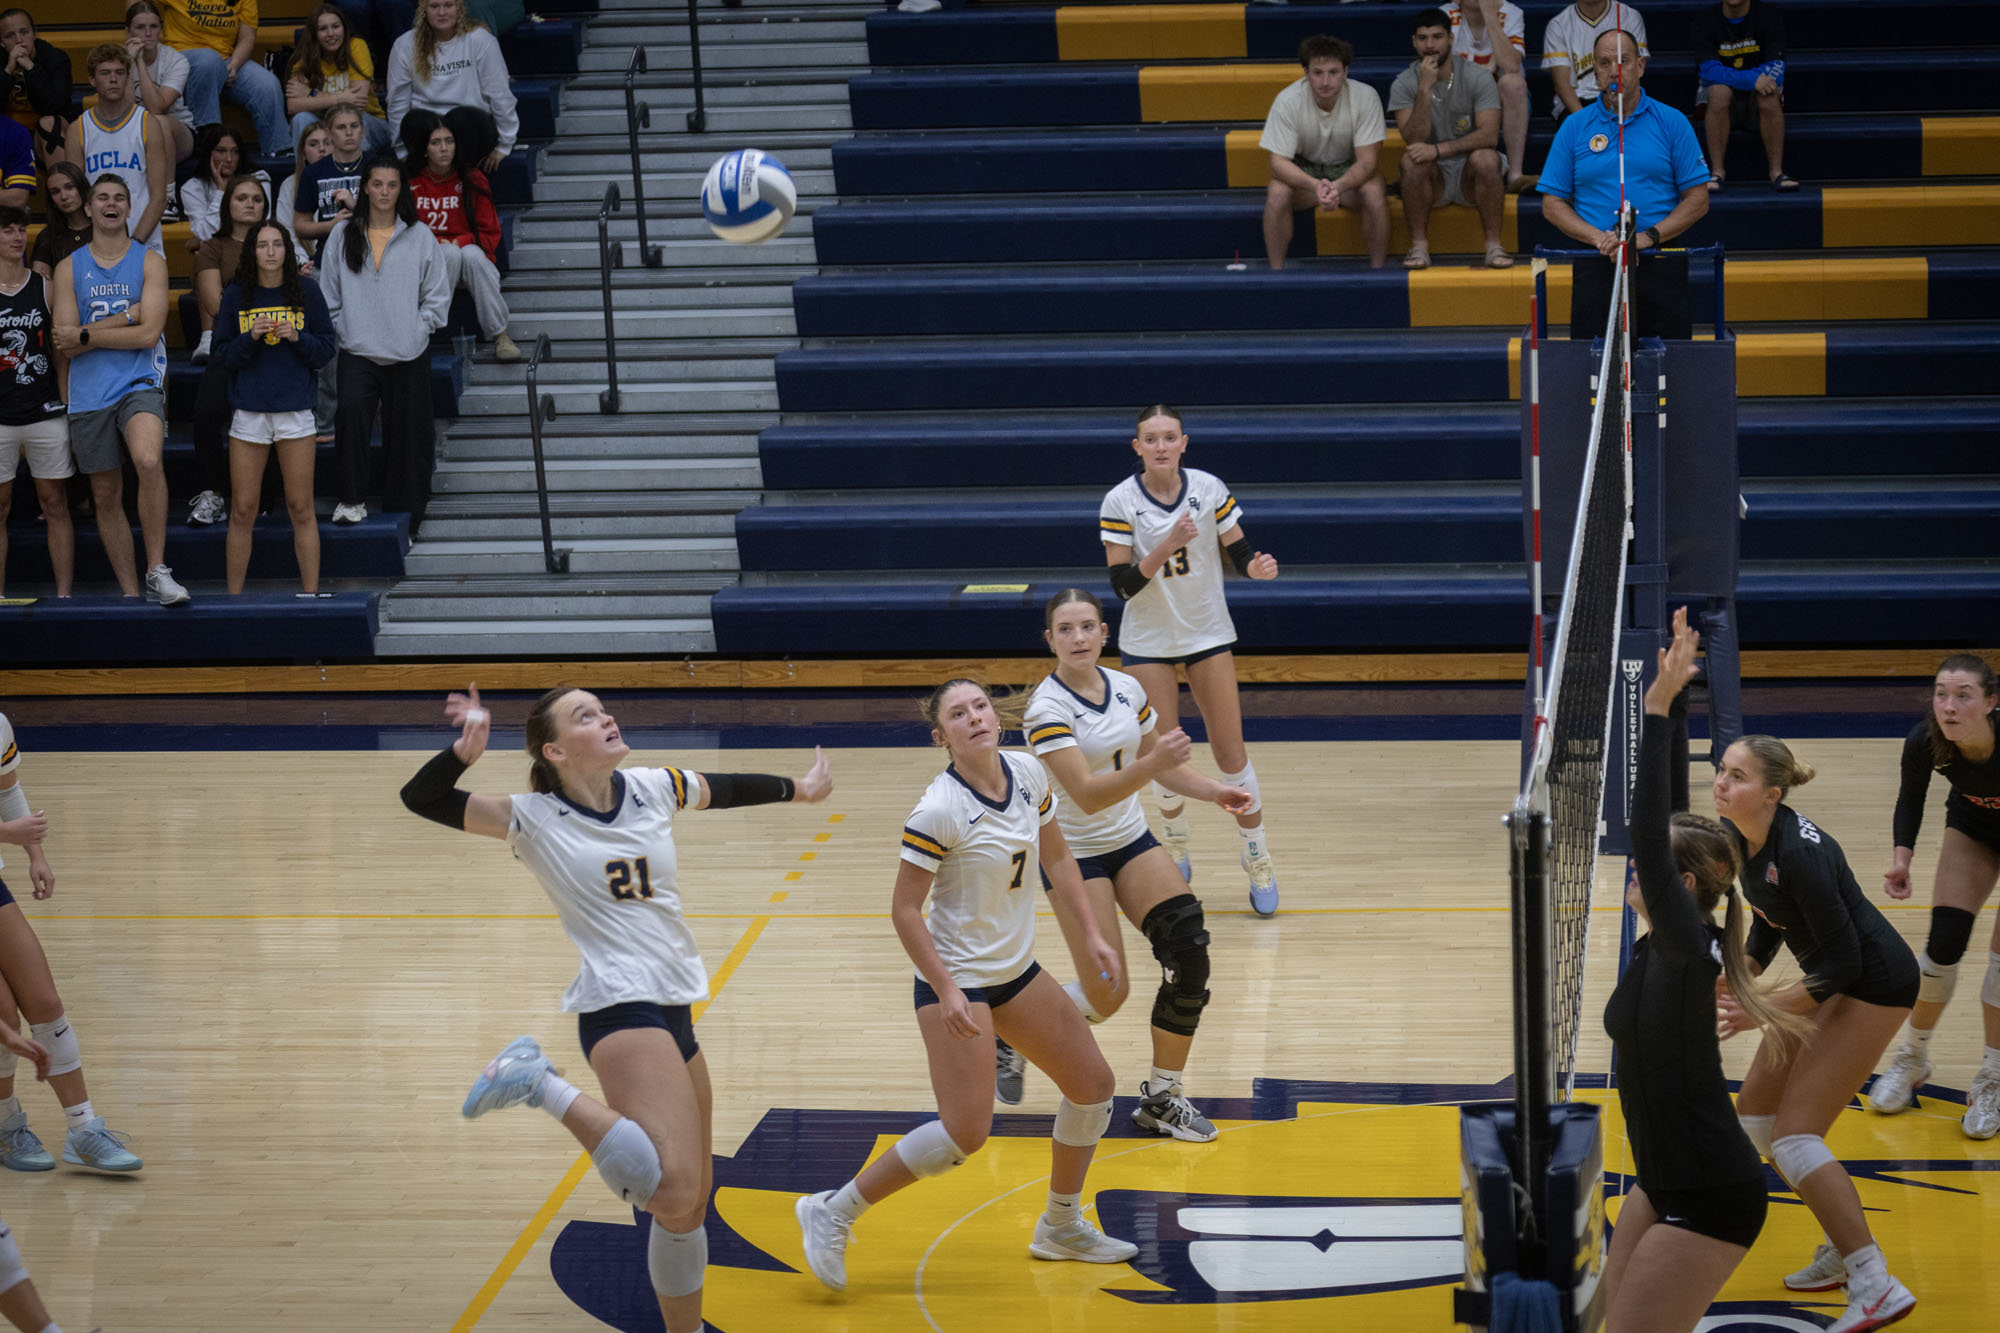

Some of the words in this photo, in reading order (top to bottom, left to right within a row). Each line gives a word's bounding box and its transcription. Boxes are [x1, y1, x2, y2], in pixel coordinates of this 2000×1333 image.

[195, 15, 235, 28] Nation
[86, 151, 142, 173] UCLA
[416, 195, 459, 210] FEVER
[427, 211, 448, 230] 22
[90, 283, 130, 298] NORTH
[238, 310, 305, 335] BEVERS
[1162, 545, 1192, 579] 13
[1629, 685, 1637, 764] VOLLEYBALL
[1112, 748, 1123, 771] 1
[605, 856, 654, 902] 21
[1008, 849, 1028, 891] 7
